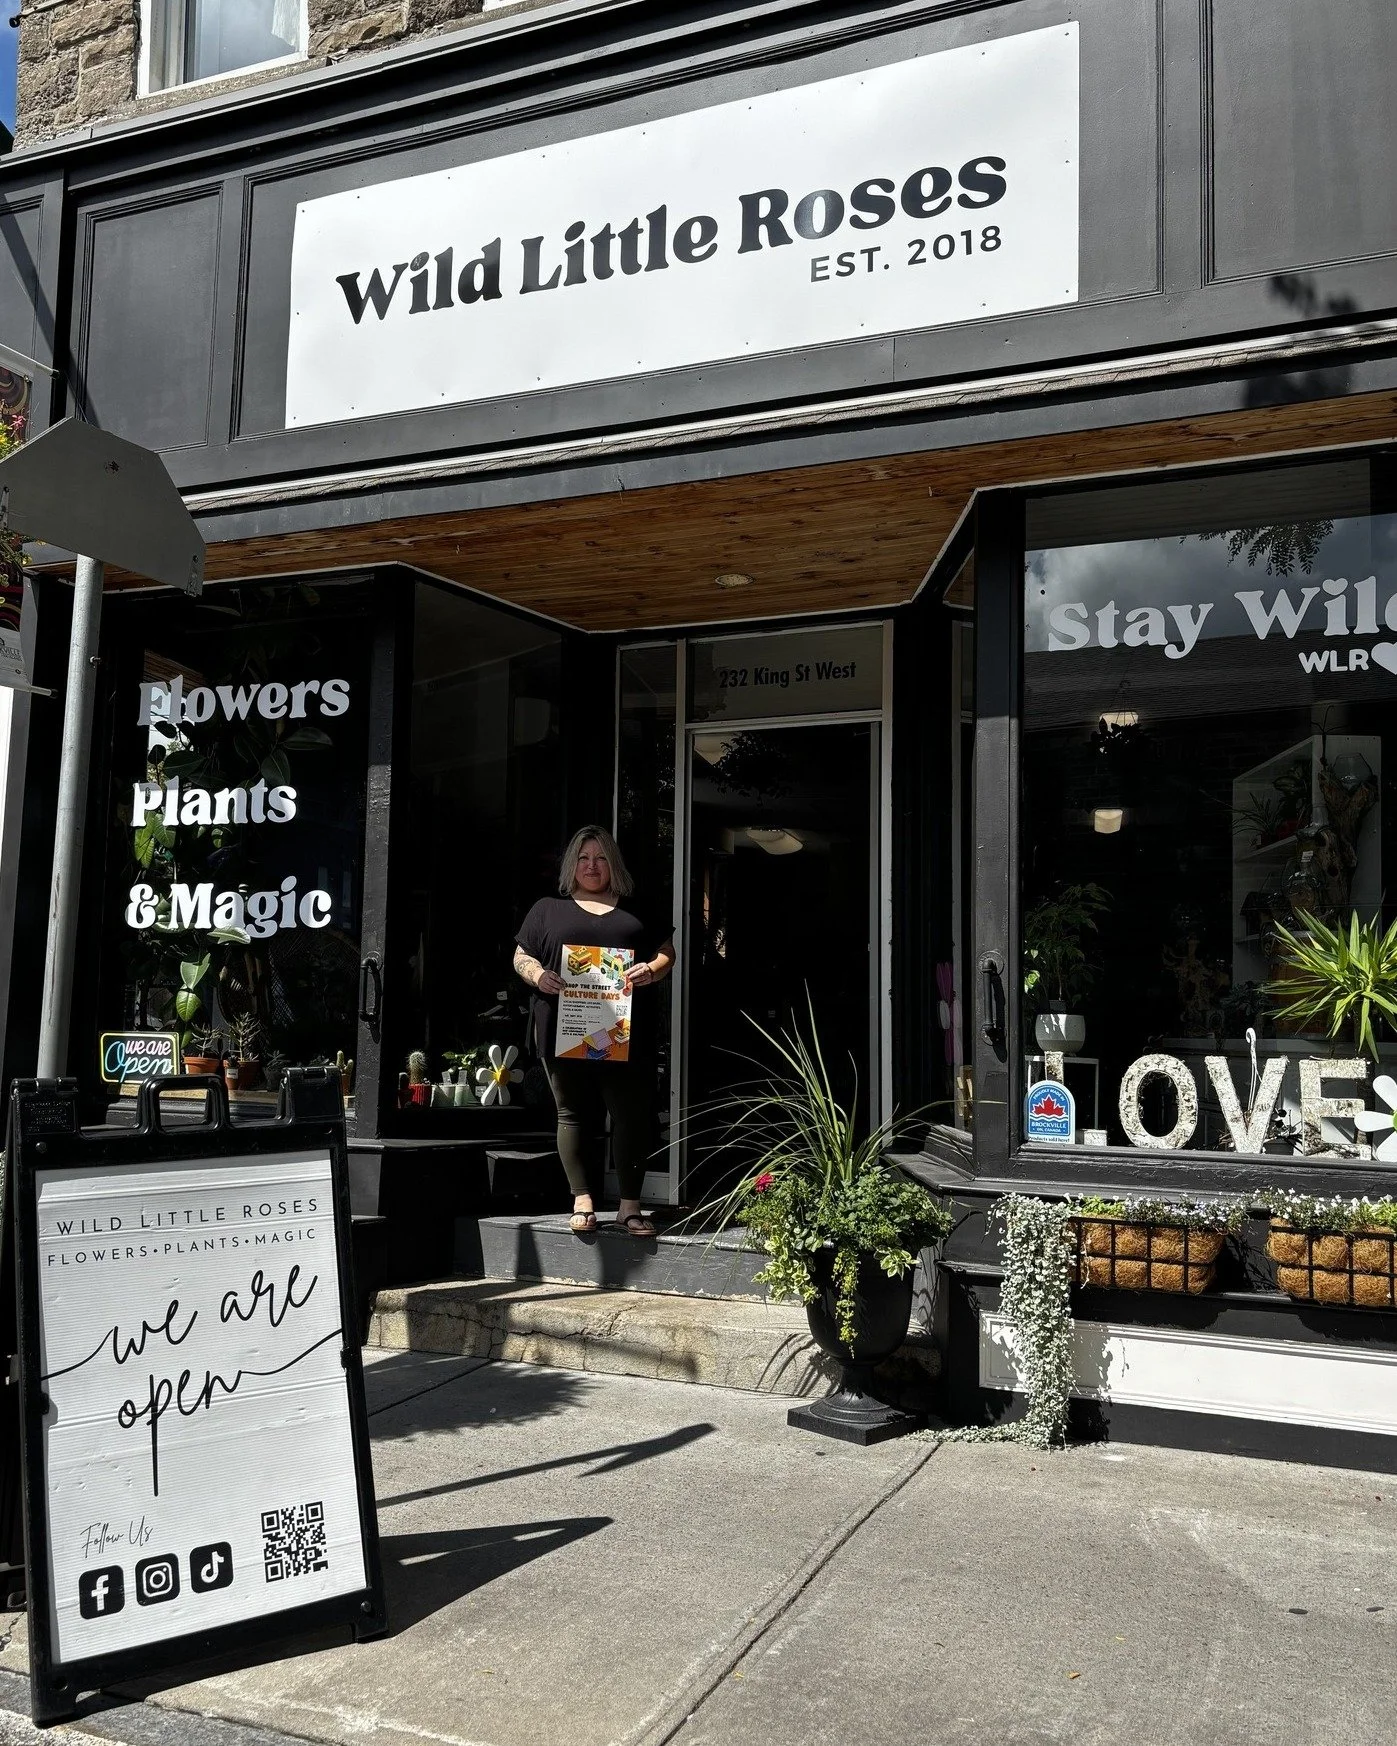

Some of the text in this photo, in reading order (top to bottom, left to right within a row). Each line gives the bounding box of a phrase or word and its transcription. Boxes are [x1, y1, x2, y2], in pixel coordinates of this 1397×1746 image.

[335, 155, 1007, 325] Wild Little Roses
[810, 225, 1002, 283] EST. 2018
[1048, 600, 1214, 659] Stay
[718, 661, 857, 689] 232 King St West
[1298, 648, 1369, 674] WLR
[137, 674, 350, 727] Flowers
[130, 775, 297, 828] Plants
[124, 875, 332, 939] & Magic
[563, 990, 620, 1001] CULTURE DAYS
[105, 1041, 173, 1083] Open
[1031, 1121, 1067, 1129] BROCKVILLE
[56, 1198, 318, 1236] WILD LITTLE ROSES
[220, 1264, 318, 1328] are
[80, 1515, 154, 1559] Follow Us
